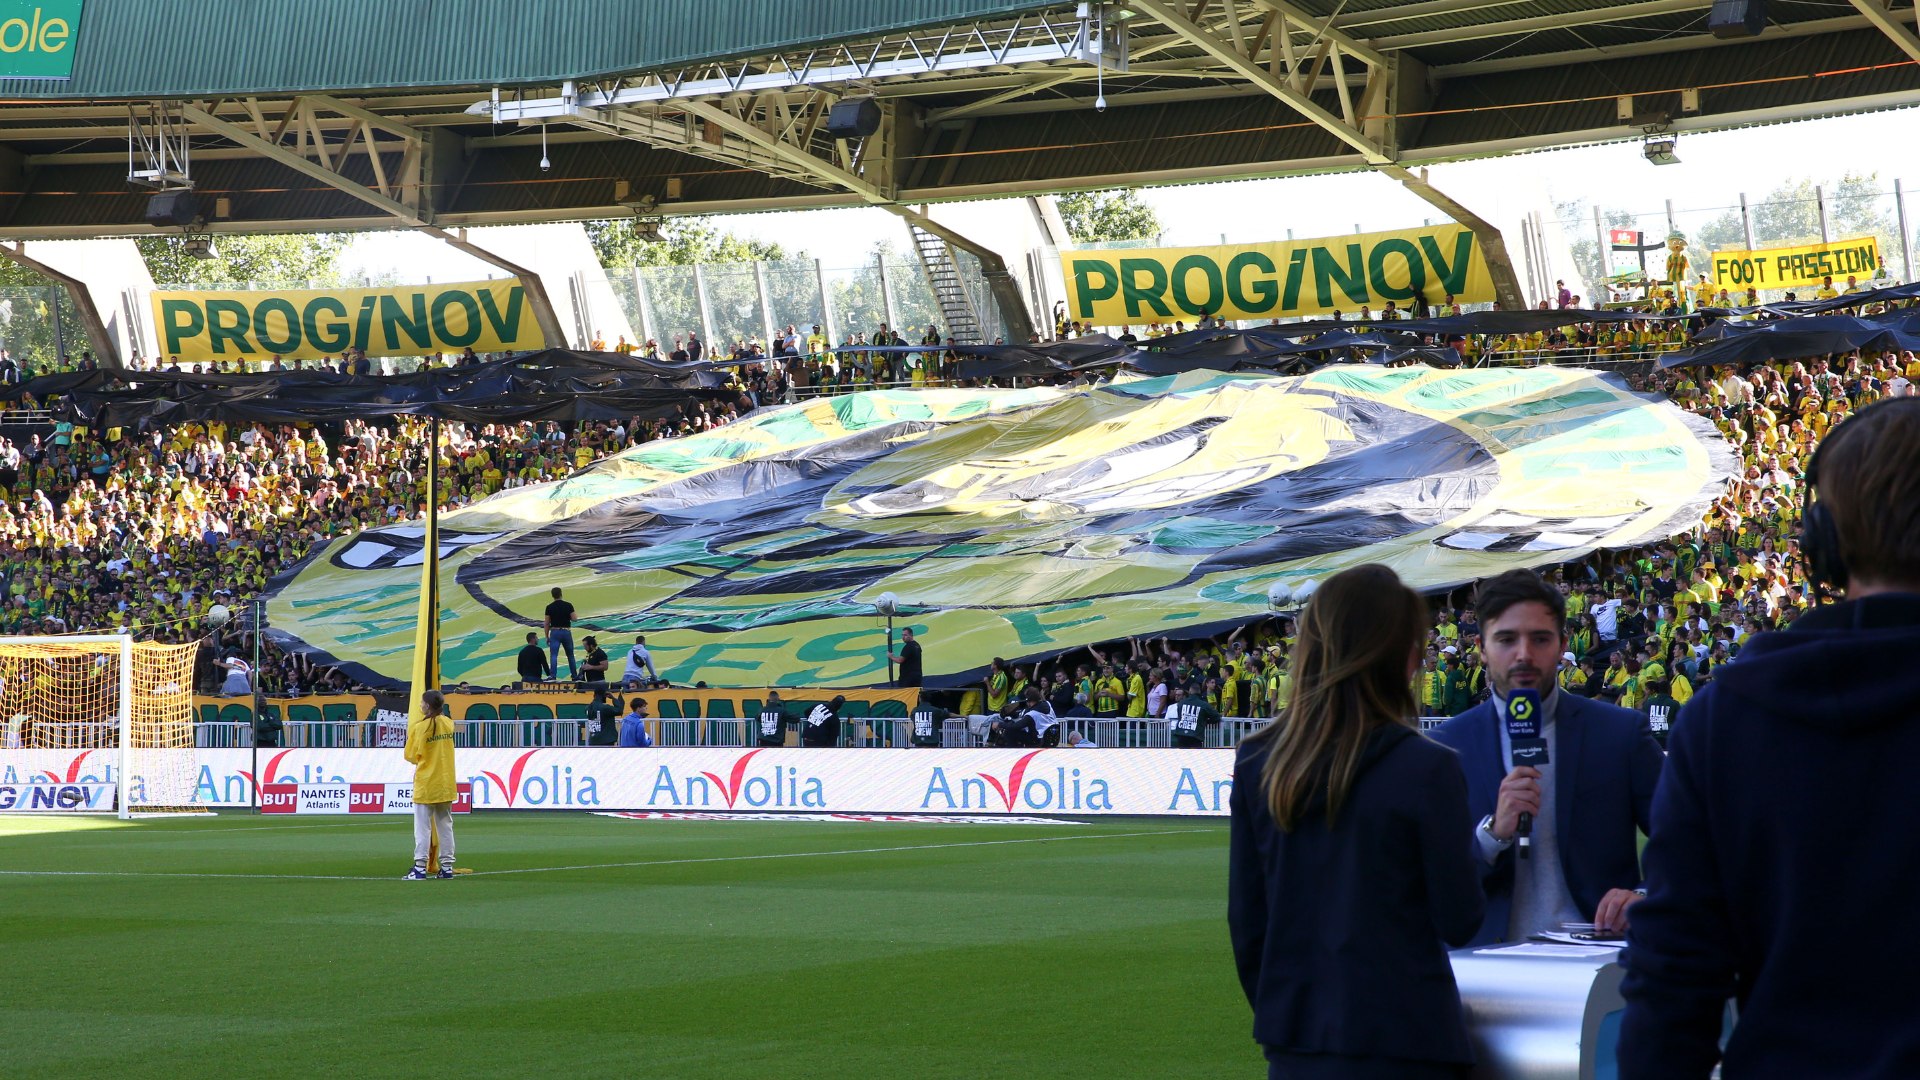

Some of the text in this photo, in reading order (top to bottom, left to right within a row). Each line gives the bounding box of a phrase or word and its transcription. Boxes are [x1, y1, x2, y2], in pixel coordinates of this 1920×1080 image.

[0, 8, 69, 53] ole
[1716, 244, 1876, 285] FOOT PASSION
[914, 711, 928, 722] ALL
[1181, 704, 1196, 717] ALL
[1650, 705, 1665, 717] ALL
[263, 793, 297, 805] BUT
[301, 789, 346, 798] NANTES
[350, 793, 384, 805] BUT
[306, 801, 340, 809] Atlantis
